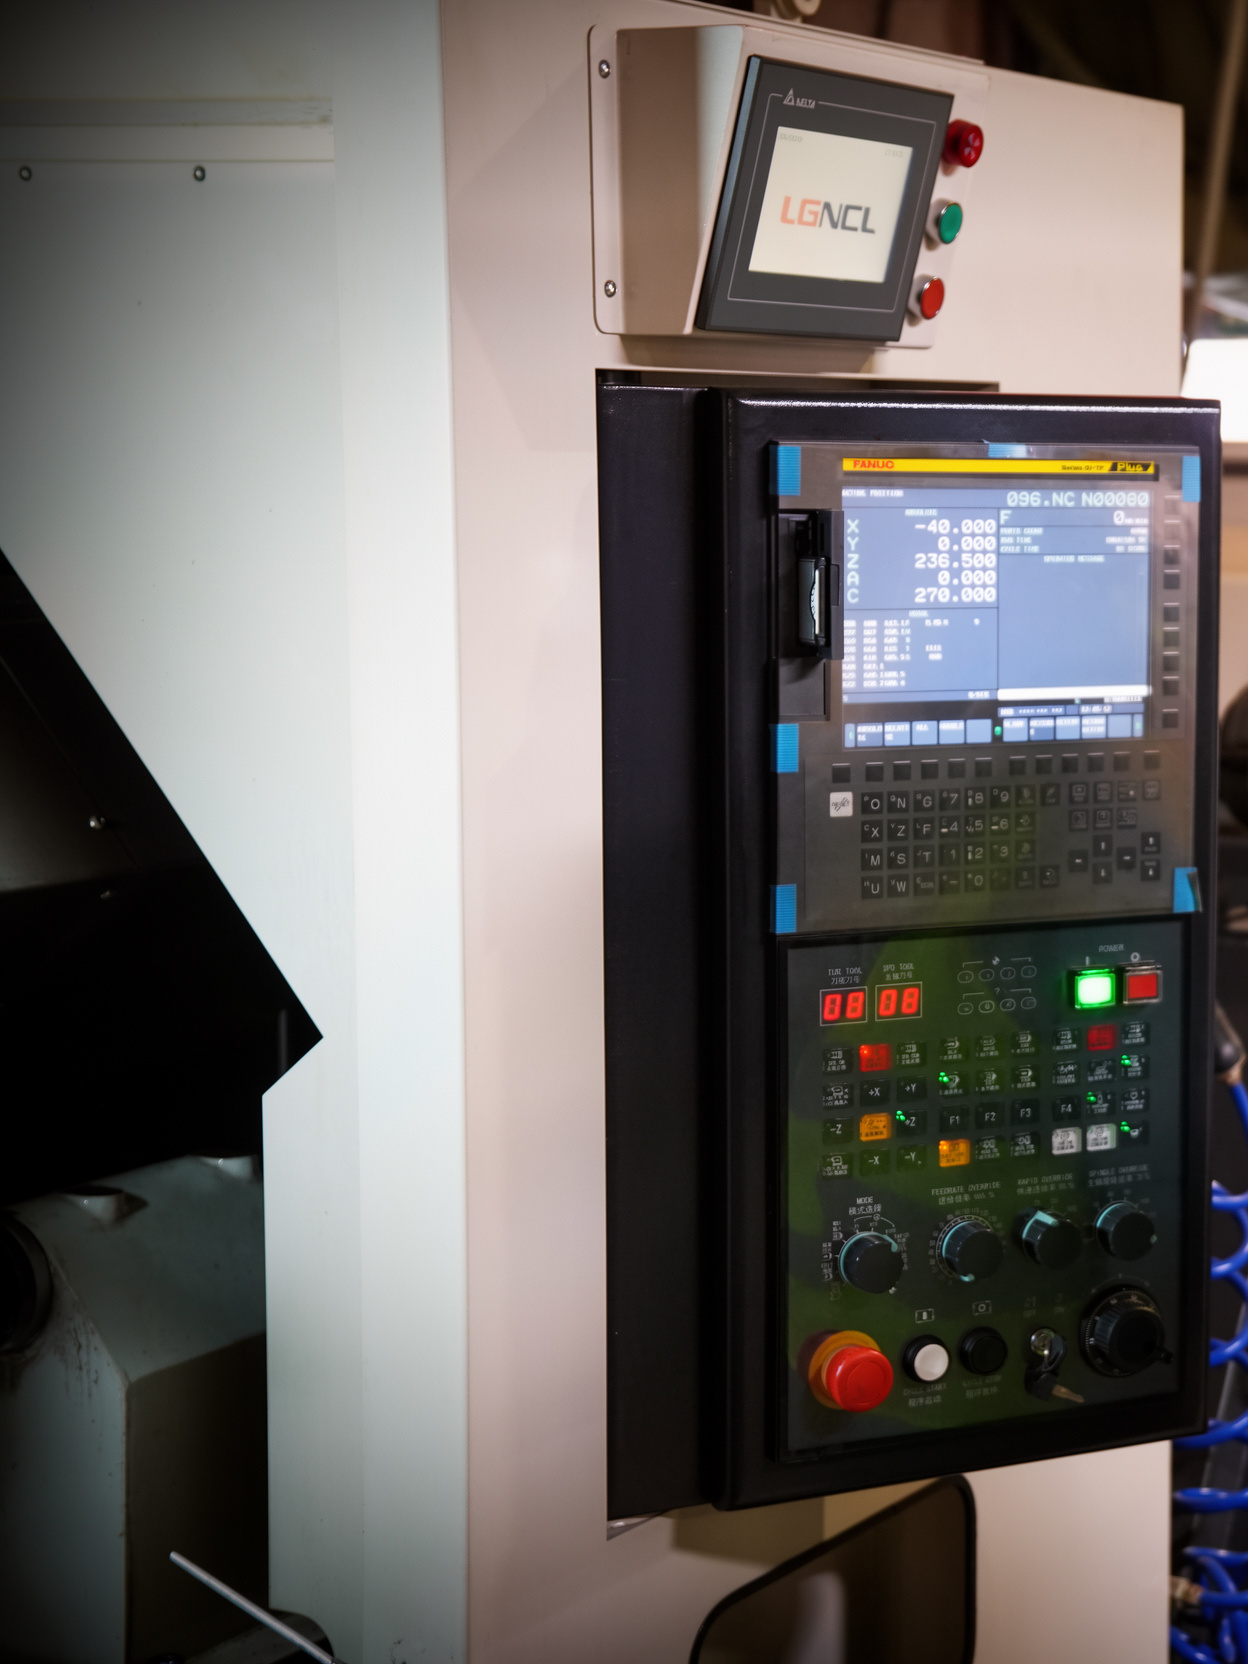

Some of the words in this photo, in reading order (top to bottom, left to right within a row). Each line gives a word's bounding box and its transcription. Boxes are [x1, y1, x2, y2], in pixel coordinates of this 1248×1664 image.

[780, 195, 875, 234] LGNCL
[853, 460, 895, 469] FANUC
[1081, 492, 1150, 508] N00080
[1000, 510, 1012, 525] F
[847, 519, 859, 534] X
[915, 519, 996, 534] -40.000
[847, 536, 859, 551] Y
[938, 536, 996, 551] 0.000
[847, 553, 859, 569] Z
[914, 553, 996, 569] 236.500
[847, 571, 859, 586] A
[938, 570, 996, 585] 0.000
[847, 588, 859, 603] C
[914, 587, 996, 602] 270.000
[923, 796, 932, 807] G
[950, 794, 958, 804] 7
[1000, 791, 1009, 802] 9
[897, 798, 905, 808] N
[923, 824, 931, 834] F
[975, 820, 983, 831] 5
[1000, 818, 1008, 830] 6
[871, 827, 879, 837] X
[897, 826, 905, 836] Z
[923, 852, 931, 862] T
[975, 848, 983, 858] 2
[1000, 846, 1008, 857] 3
[870, 855, 880, 866] M
[897, 853, 906, 864] S
[871, 883, 879, 894] U
[896, 881, 906, 892] W
[1098, 944, 1124, 952] POWER
[823, 991, 865, 1021] 08
[878, 987, 920, 1017] 08
[868, 1088, 880, 1096] +X
[905, 1084, 916, 1093] +Y
[1020, 1108, 1032, 1118] F3
[1061, 1104, 1072, 1113] F4
[950, 1116, 960, 1125] F1
[985, 1112, 996, 1122] F2
[830, 1124, 842, 1134] -Z
[868, 1156, 879, 1165] -X
[932, 1186, 964, 1196] FEEDRATE
[968, 1182, 1001, 1192] OVERRIDE
[856, 1196, 874, 1204] MODE
